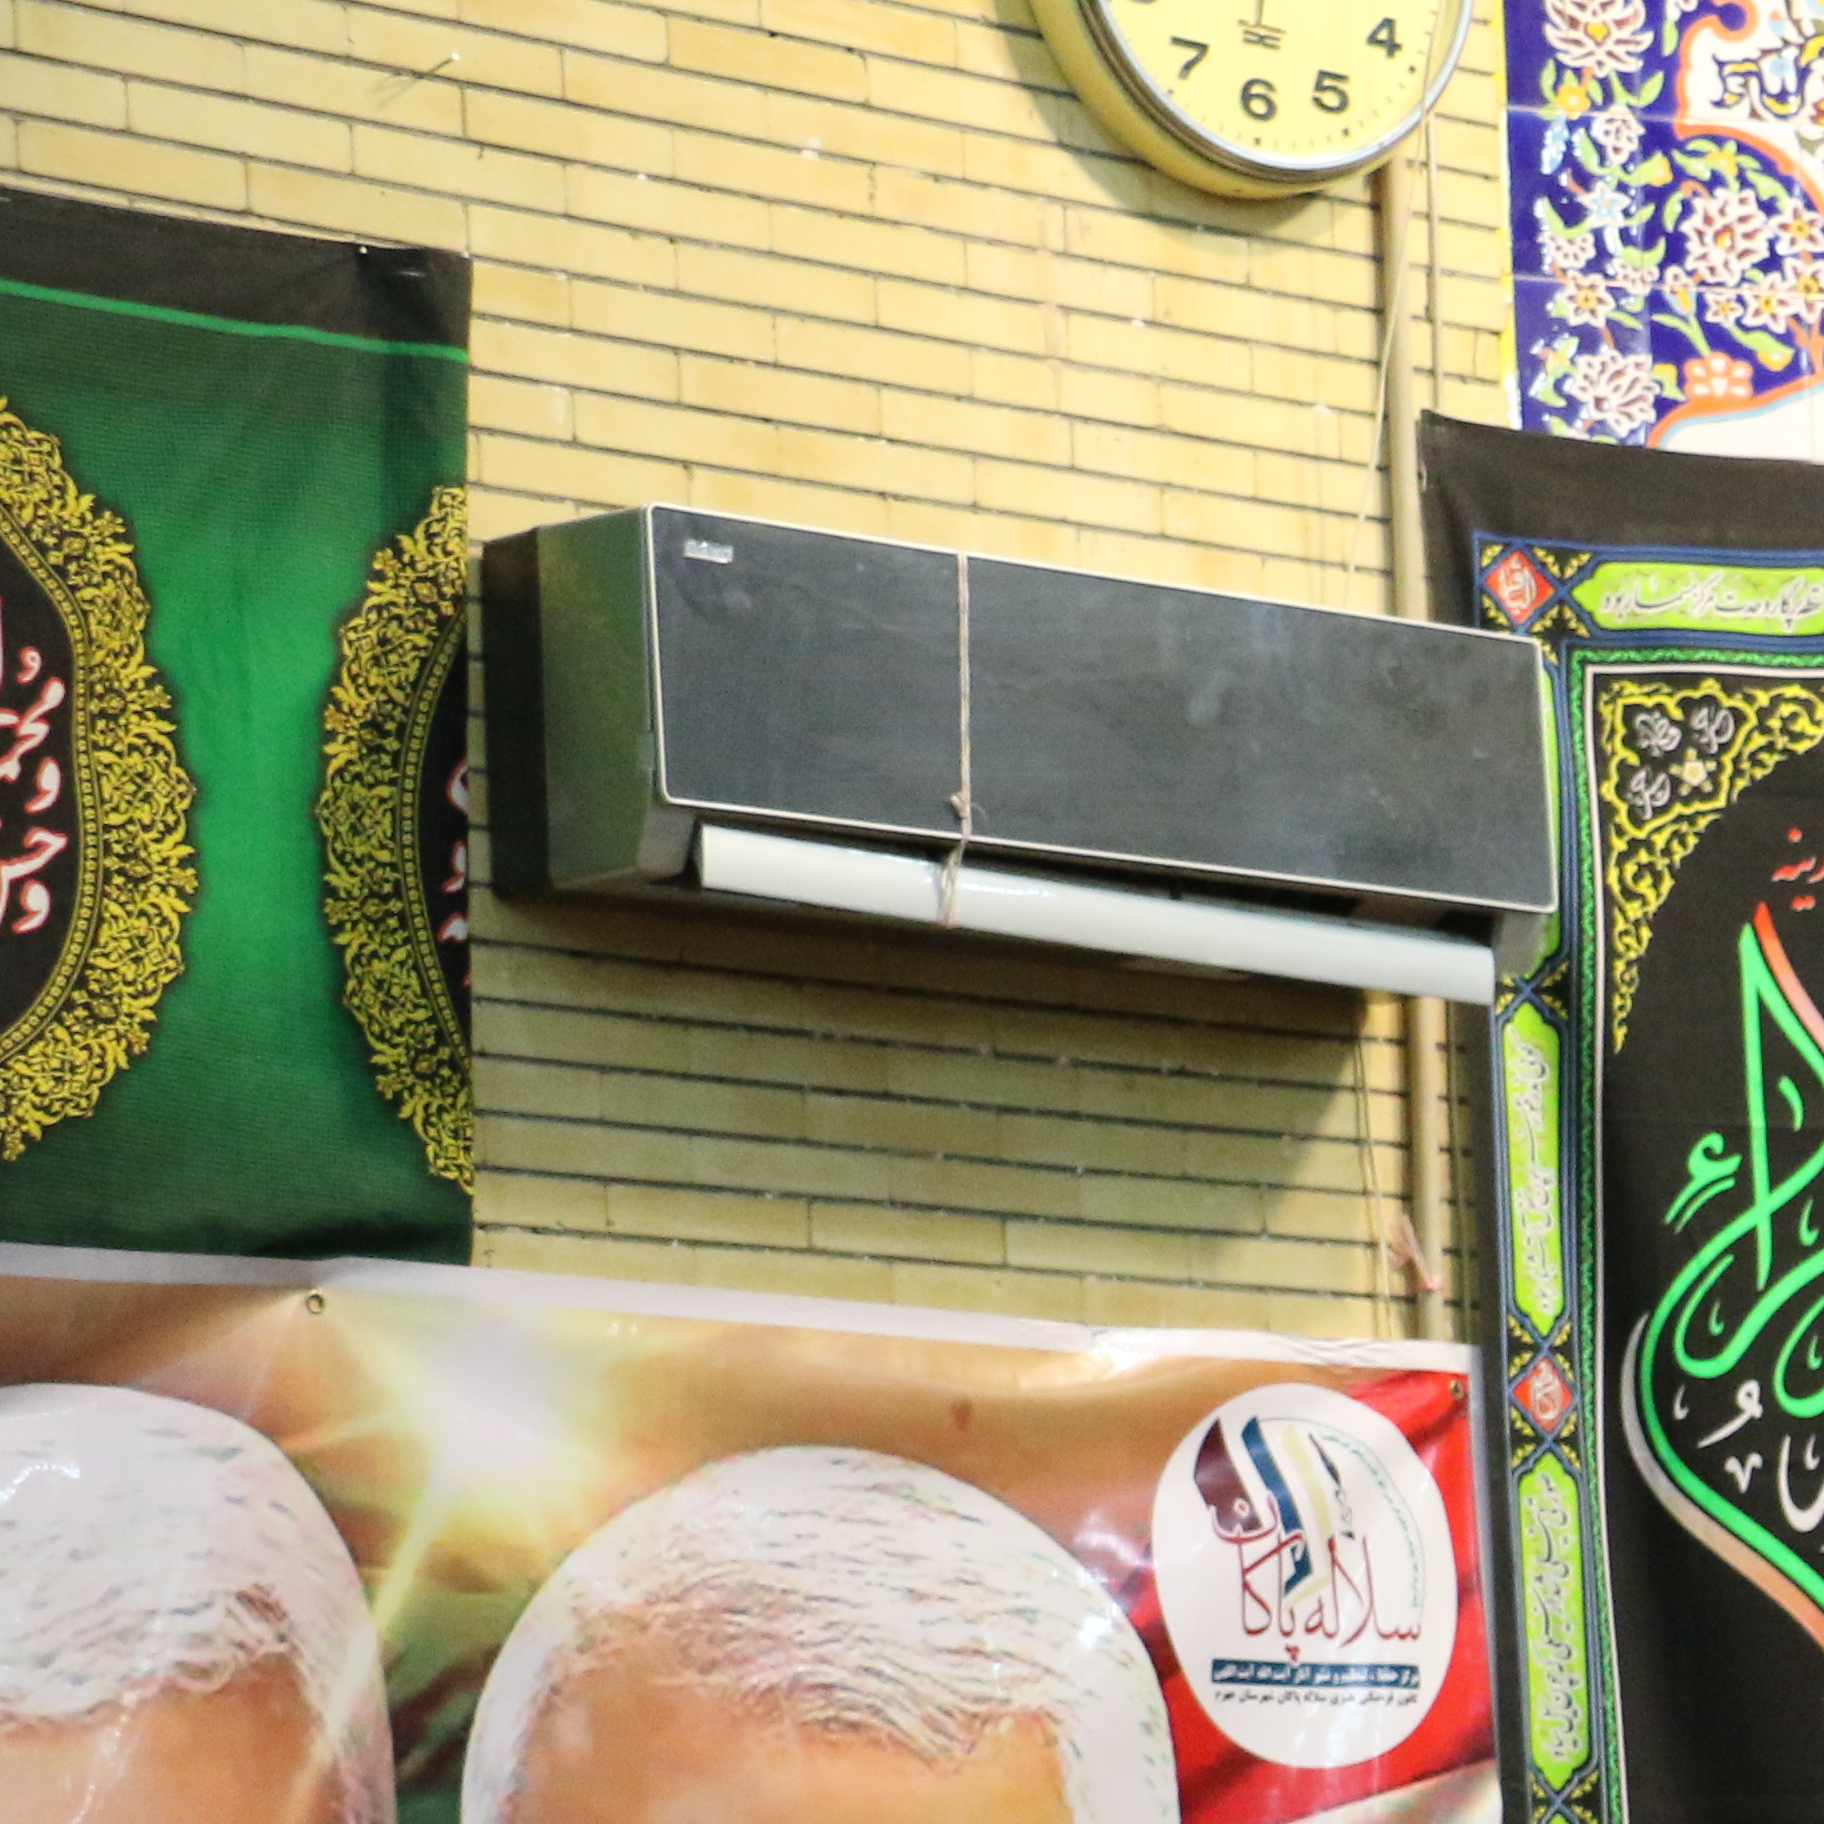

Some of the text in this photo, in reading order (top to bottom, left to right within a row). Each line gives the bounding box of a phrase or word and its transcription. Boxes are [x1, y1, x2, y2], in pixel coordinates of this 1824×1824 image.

[1169, 36, 1209, 80] 7
[1366, 18, 1402, 58] 4
[1240, 78, 1278, 122] 6
[1312, 69, 1351, 114] 5
